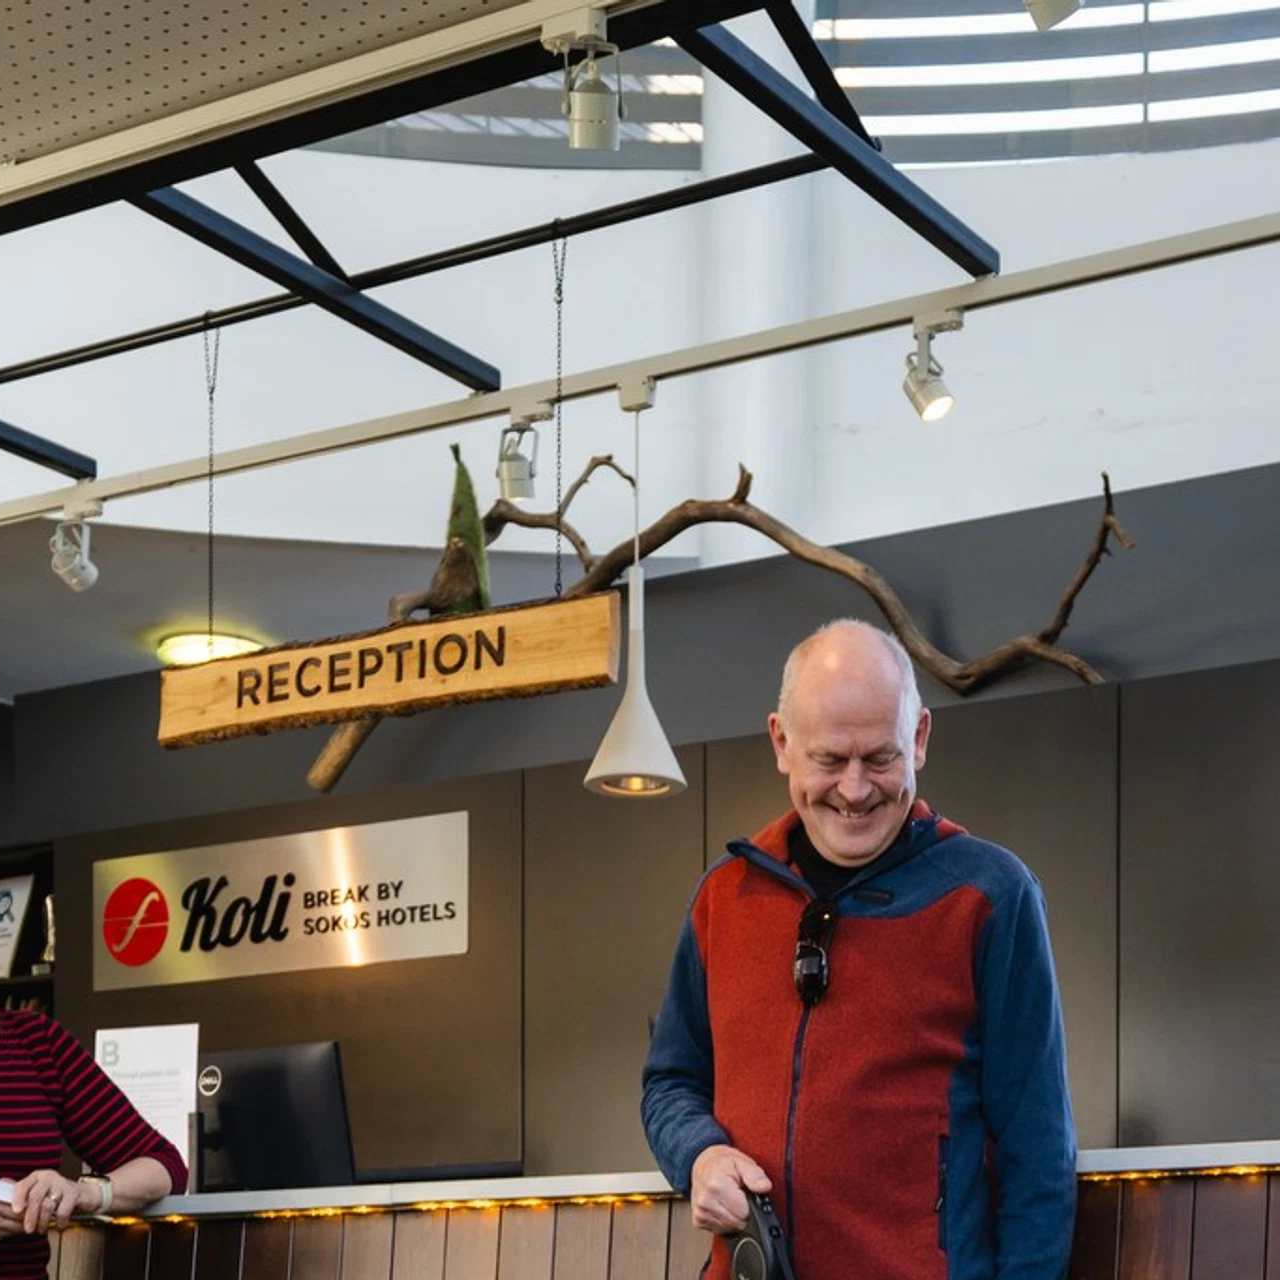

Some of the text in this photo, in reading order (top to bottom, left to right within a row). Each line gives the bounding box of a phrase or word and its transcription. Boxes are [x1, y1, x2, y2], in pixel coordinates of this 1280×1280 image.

[236, 626, 506, 709] RECEPTION
[303, 880, 404, 909] BREAK BY
[179, 871, 296, 953] Koli
[303, 902, 457, 936] SOKOS HOTELS
[102, 1040, 120, 1067] B
